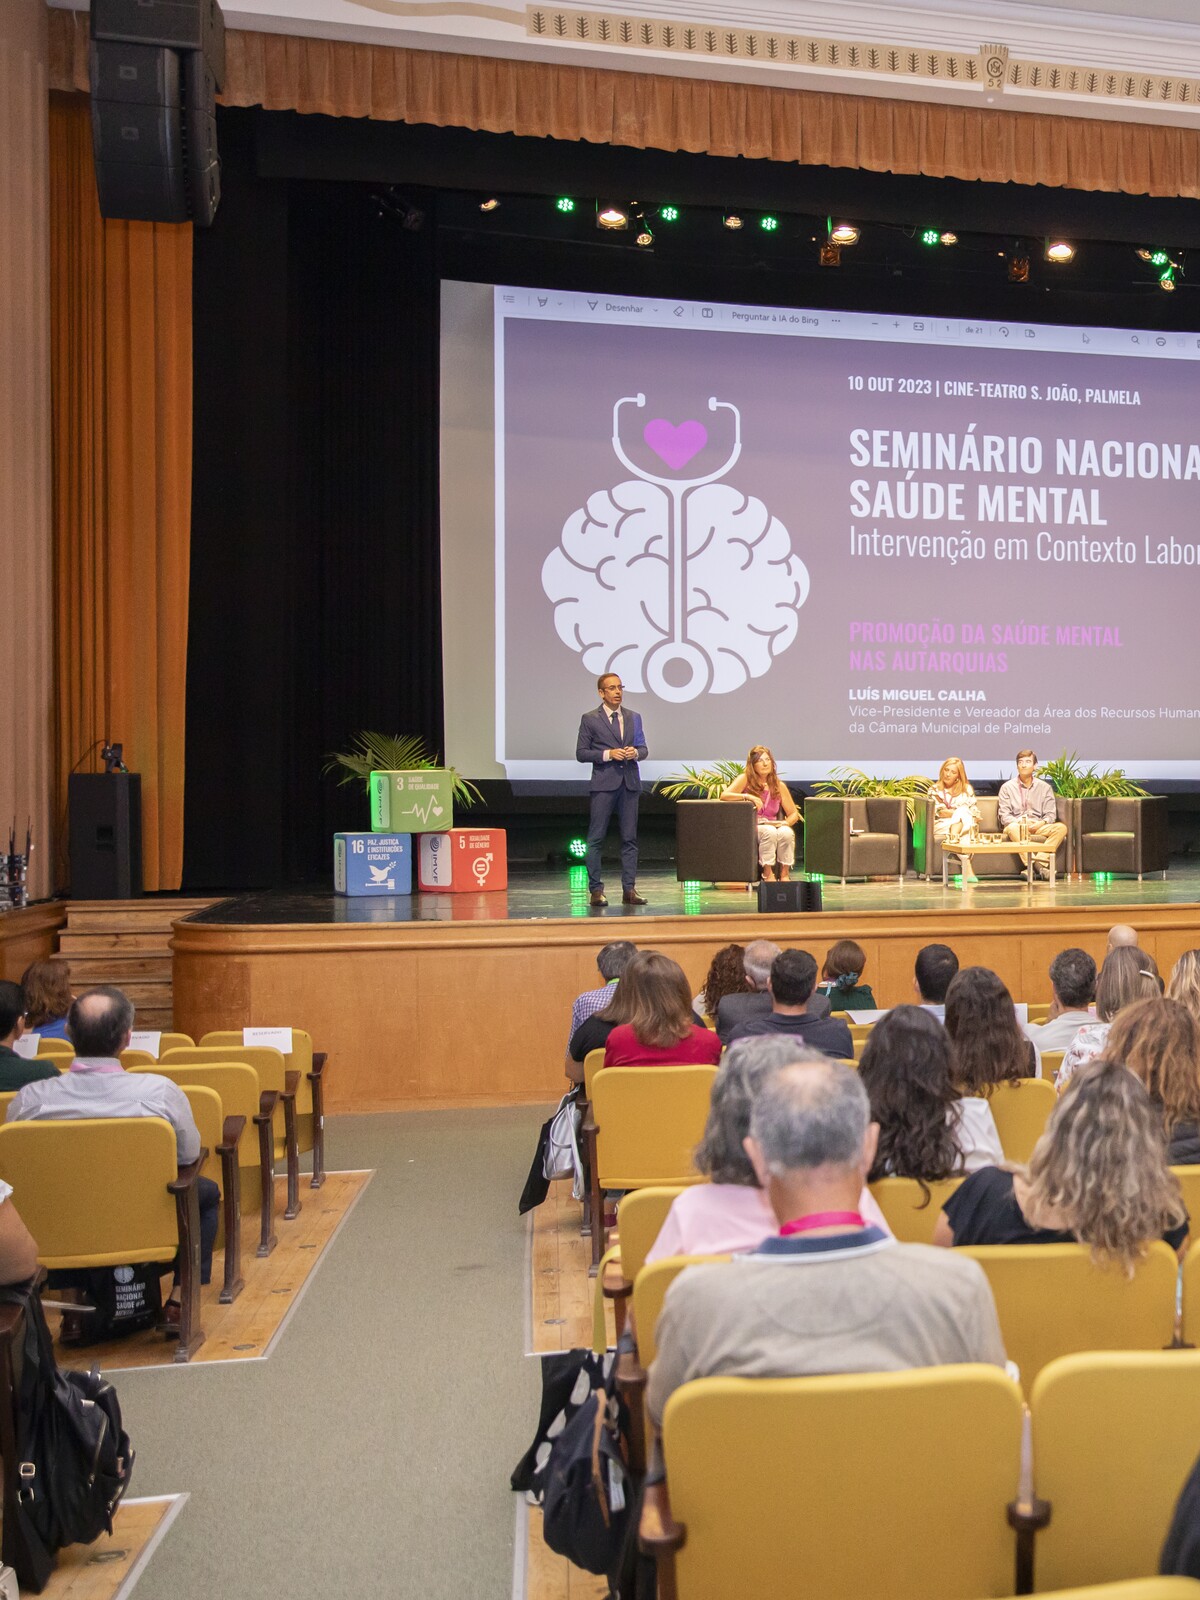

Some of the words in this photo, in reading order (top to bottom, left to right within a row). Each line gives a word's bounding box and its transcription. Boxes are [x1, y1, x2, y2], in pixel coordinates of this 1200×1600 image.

[605, 302, 643, 313] Desenhar
[732, 311, 769, 322] Perguntar
[789, 315, 800, 323] do
[801, 315, 819, 326] Bing
[848, 375, 864, 391] 10
[867, 376, 894, 392] OUT
[898, 378, 932, 394] 2023
[944, 381, 1027, 400] CINE-TEATRO
[1030, 385, 1042, 400] S.
[1045, 383, 1081, 404] JOÃO,
[1085, 388, 1141, 405] PALMELA
[849, 423, 1043, 475] SEMINÁRIO
[849, 470, 966, 520] SAÚDE
[977, 484, 1108, 526] MENTAL
[849, 525, 986, 565] Intervenção
[993, 537, 1028, 560] em
[1036, 531, 1137, 563] Contexto
[849, 618, 956, 648] PROMOÇÃO
[961, 623, 986, 645] DA
[991, 618, 1050, 646] SAÚDE
[1056, 625, 1124, 647] MENTAL
[849, 650, 887, 671] NAS
[892, 651, 1009, 675] AUTARQUIAS
[849, 686, 880, 701] LUÍS
[882, 689, 935, 701] MIGUEL
[938, 690, 987, 702] CALHA
[848, 705, 950, 718] Vice-Presidente
[953, 708, 961, 718] e
[964, 705, 1021, 718] Vereador
[1024, 706, 1040, 718] da
[1043, 703, 1071, 718] Área
[1074, 706, 1097, 718] dos
[1100, 706, 1156, 719] Recursos
[849, 721, 865, 733] da
[868, 721, 917, 733] Câmara
[922, 722, 980, 736] Municipal
[984, 722, 1000, 734] de
[1004, 722, 1051, 734] Palmela
[397, 776, 404, 790] 3
[352, 839, 364, 854] 16
[459, 835, 466, 849] 5
[116, 1300, 135, 1310] SAÚDE
